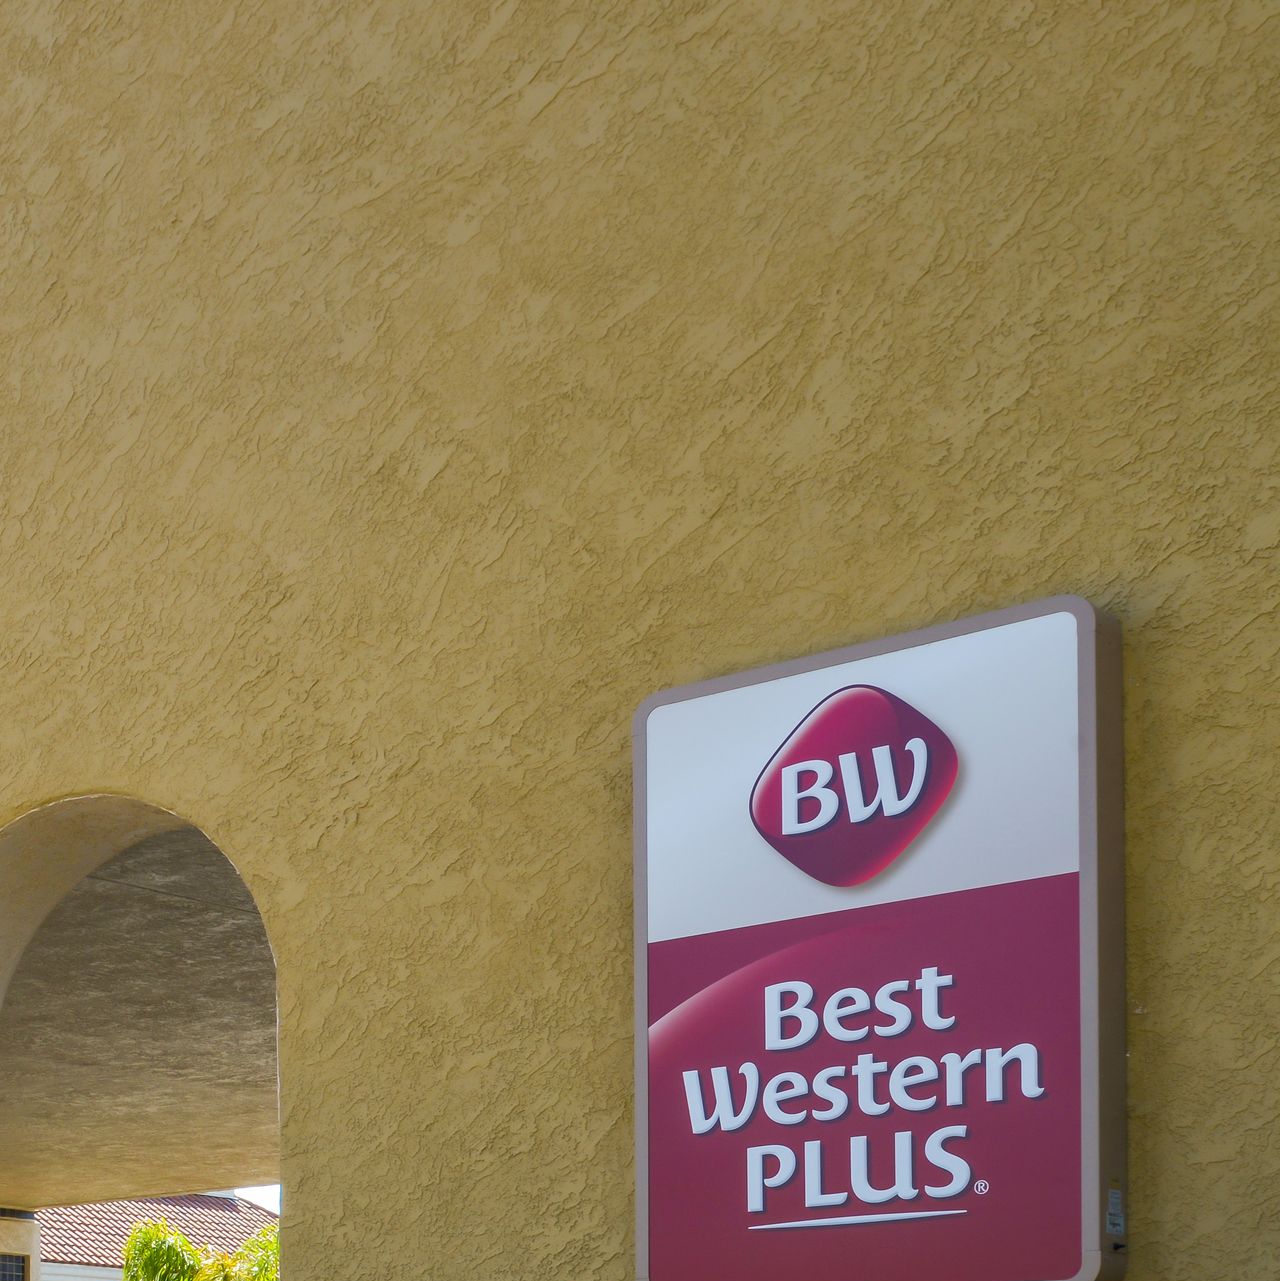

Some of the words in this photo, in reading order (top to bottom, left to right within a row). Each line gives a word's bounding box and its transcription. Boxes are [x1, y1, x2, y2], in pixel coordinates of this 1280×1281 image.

[781, 737, 929, 835] BW
[764, 966, 957, 1051] Best
[682, 1043, 1045, 1135] Western
